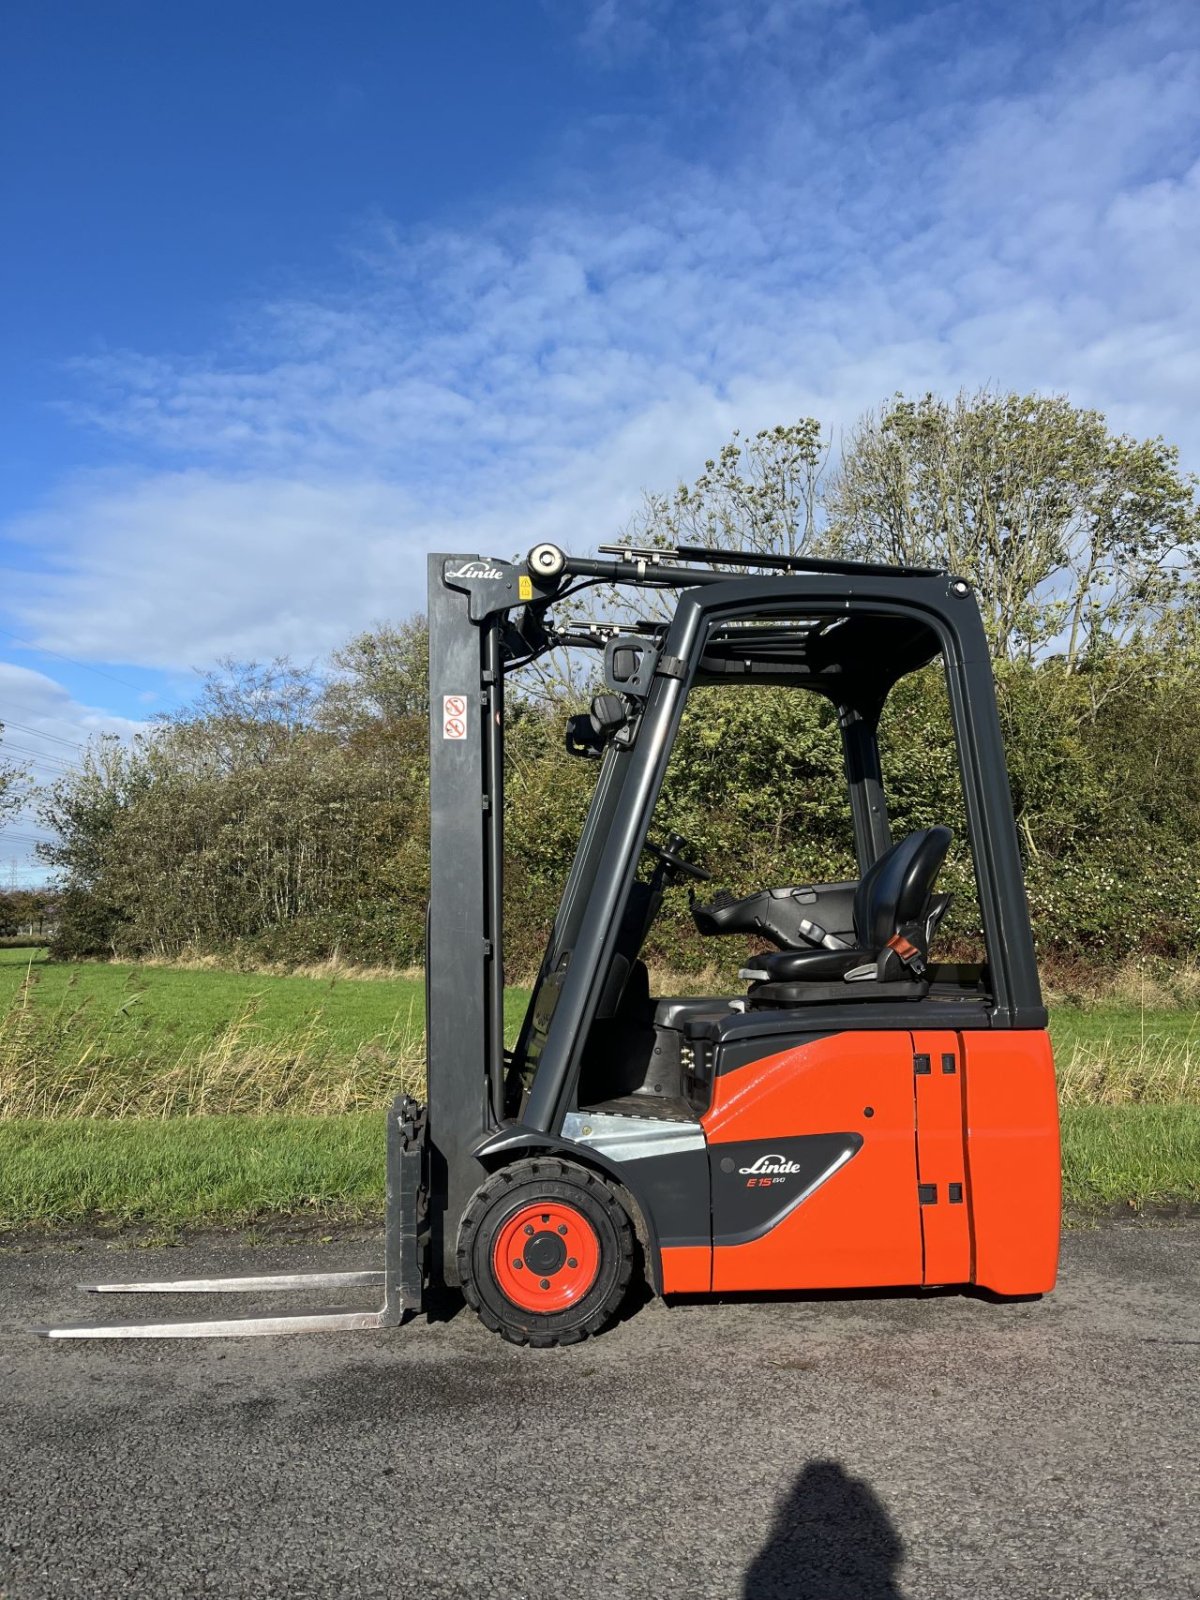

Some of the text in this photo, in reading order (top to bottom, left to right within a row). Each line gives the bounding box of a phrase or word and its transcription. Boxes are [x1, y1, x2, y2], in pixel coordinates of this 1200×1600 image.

[445, 561, 503, 579] Linde
[738, 1154, 801, 1174] Linde
[746, 1178, 757, 1187] E
[758, 1177, 772, 1187] 15
